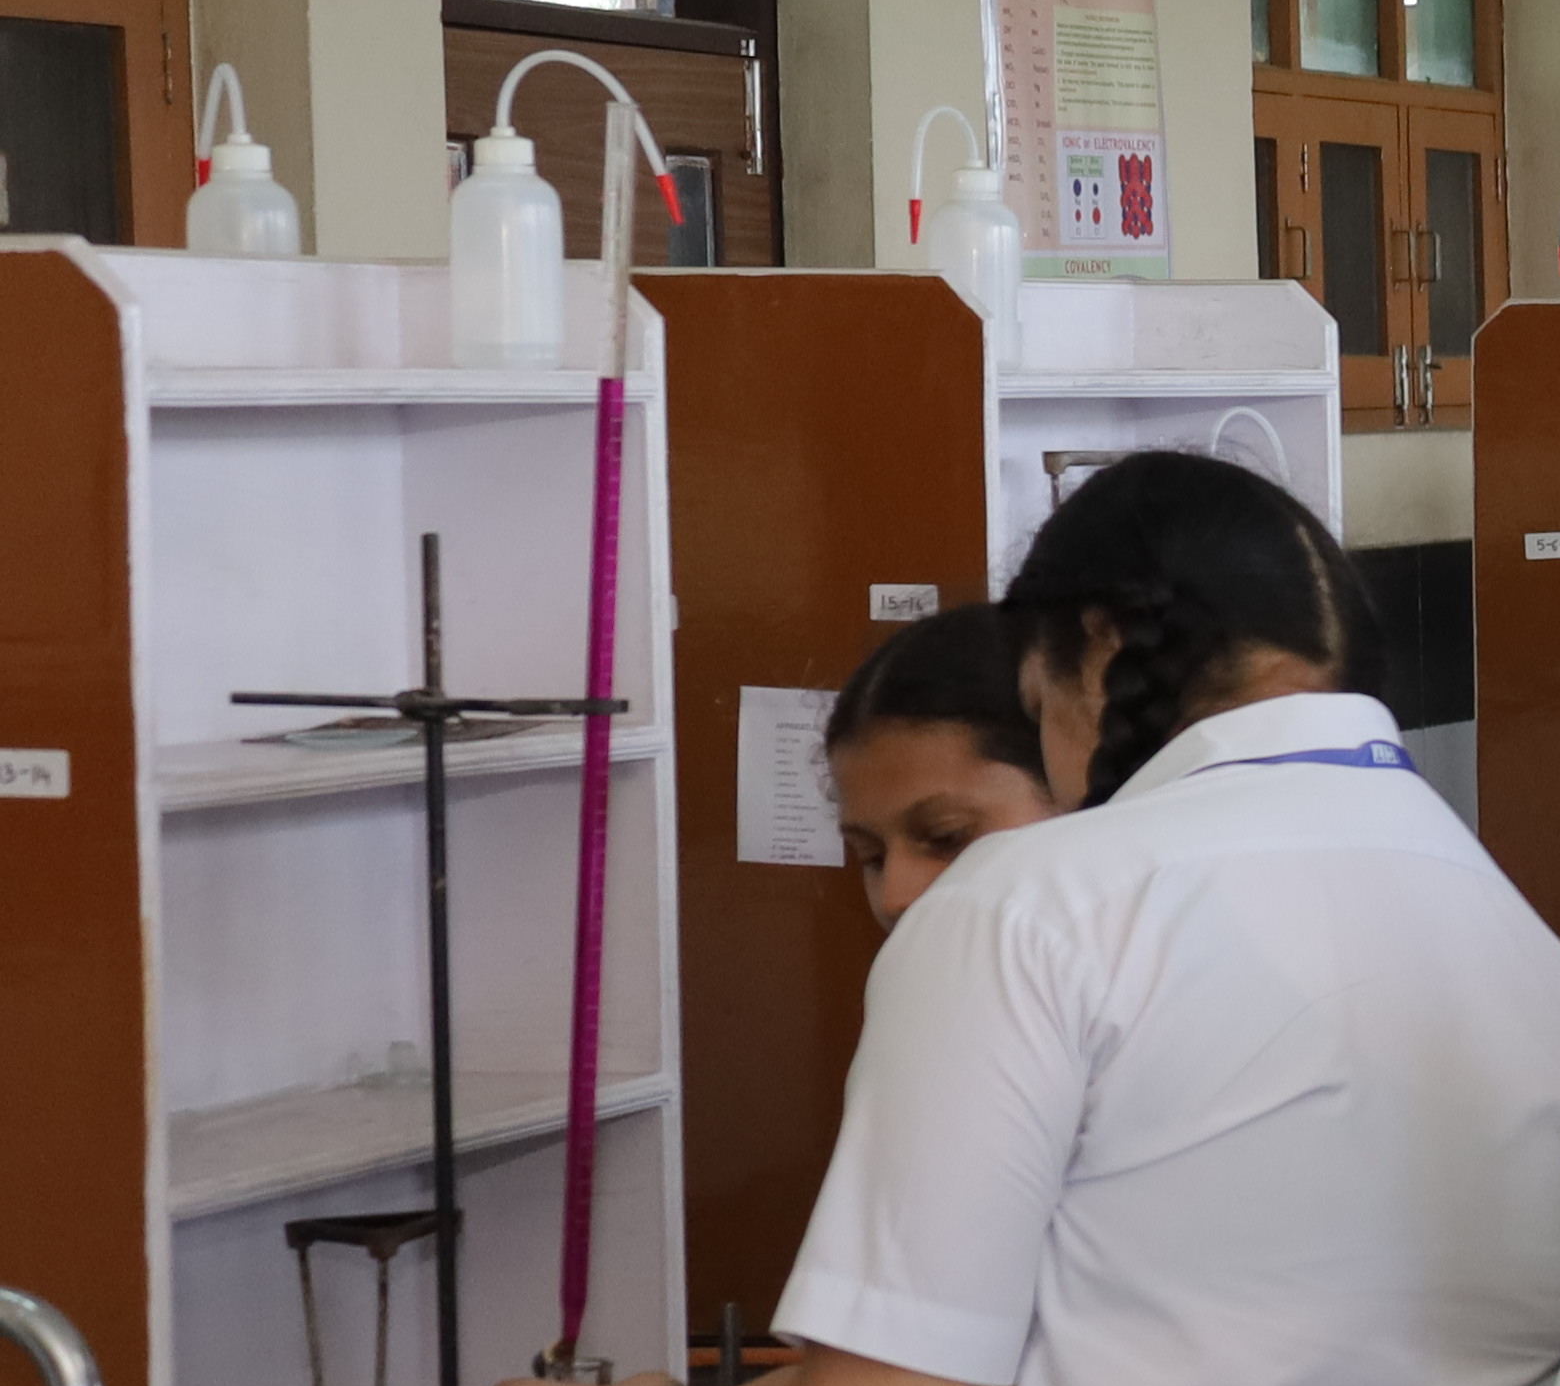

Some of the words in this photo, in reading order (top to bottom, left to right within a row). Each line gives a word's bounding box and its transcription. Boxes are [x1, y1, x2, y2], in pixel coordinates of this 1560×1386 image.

[1062, 136, 1081, 149] IONIC
[1093, 139, 1156, 151] ELECTROVALENCY
[1064, 260, 1112, 274] COVALENCY
